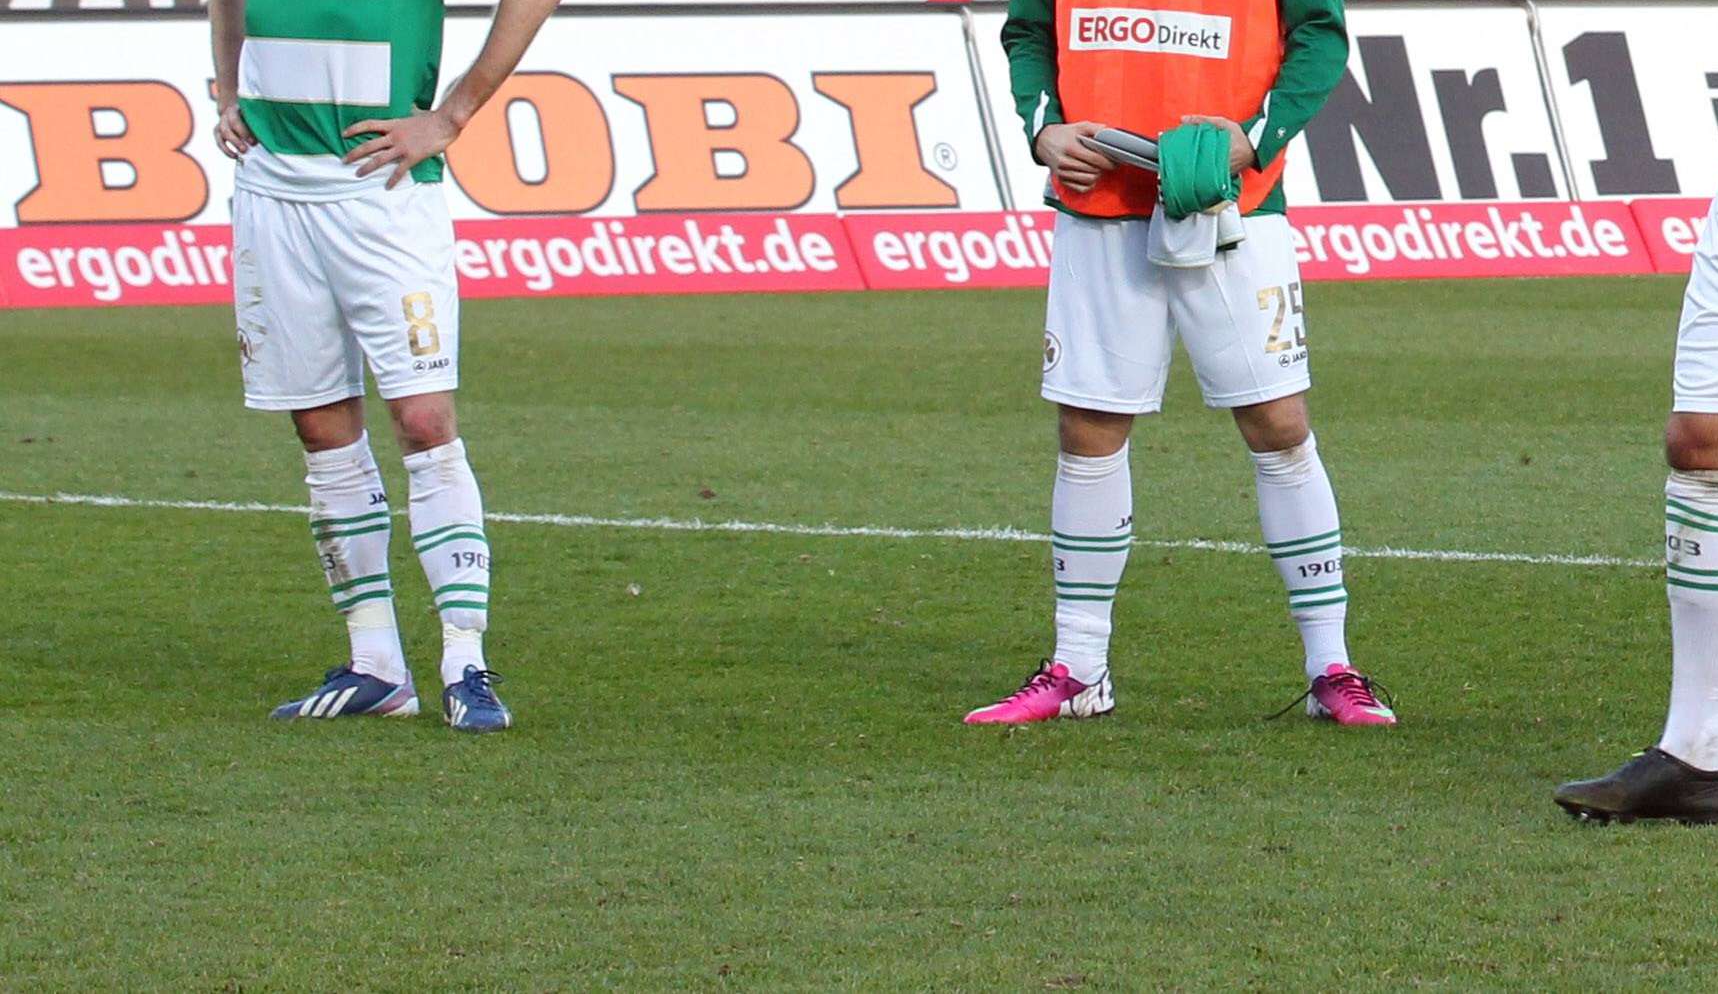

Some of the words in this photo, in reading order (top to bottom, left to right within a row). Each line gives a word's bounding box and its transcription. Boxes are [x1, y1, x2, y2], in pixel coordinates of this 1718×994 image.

[1078, 16, 1155, 43] ERGO
[1157, 25, 1221, 50] Direkt
[456, 218, 837, 291] ergodirekt.de
[402, 291, 440, 356] 8
